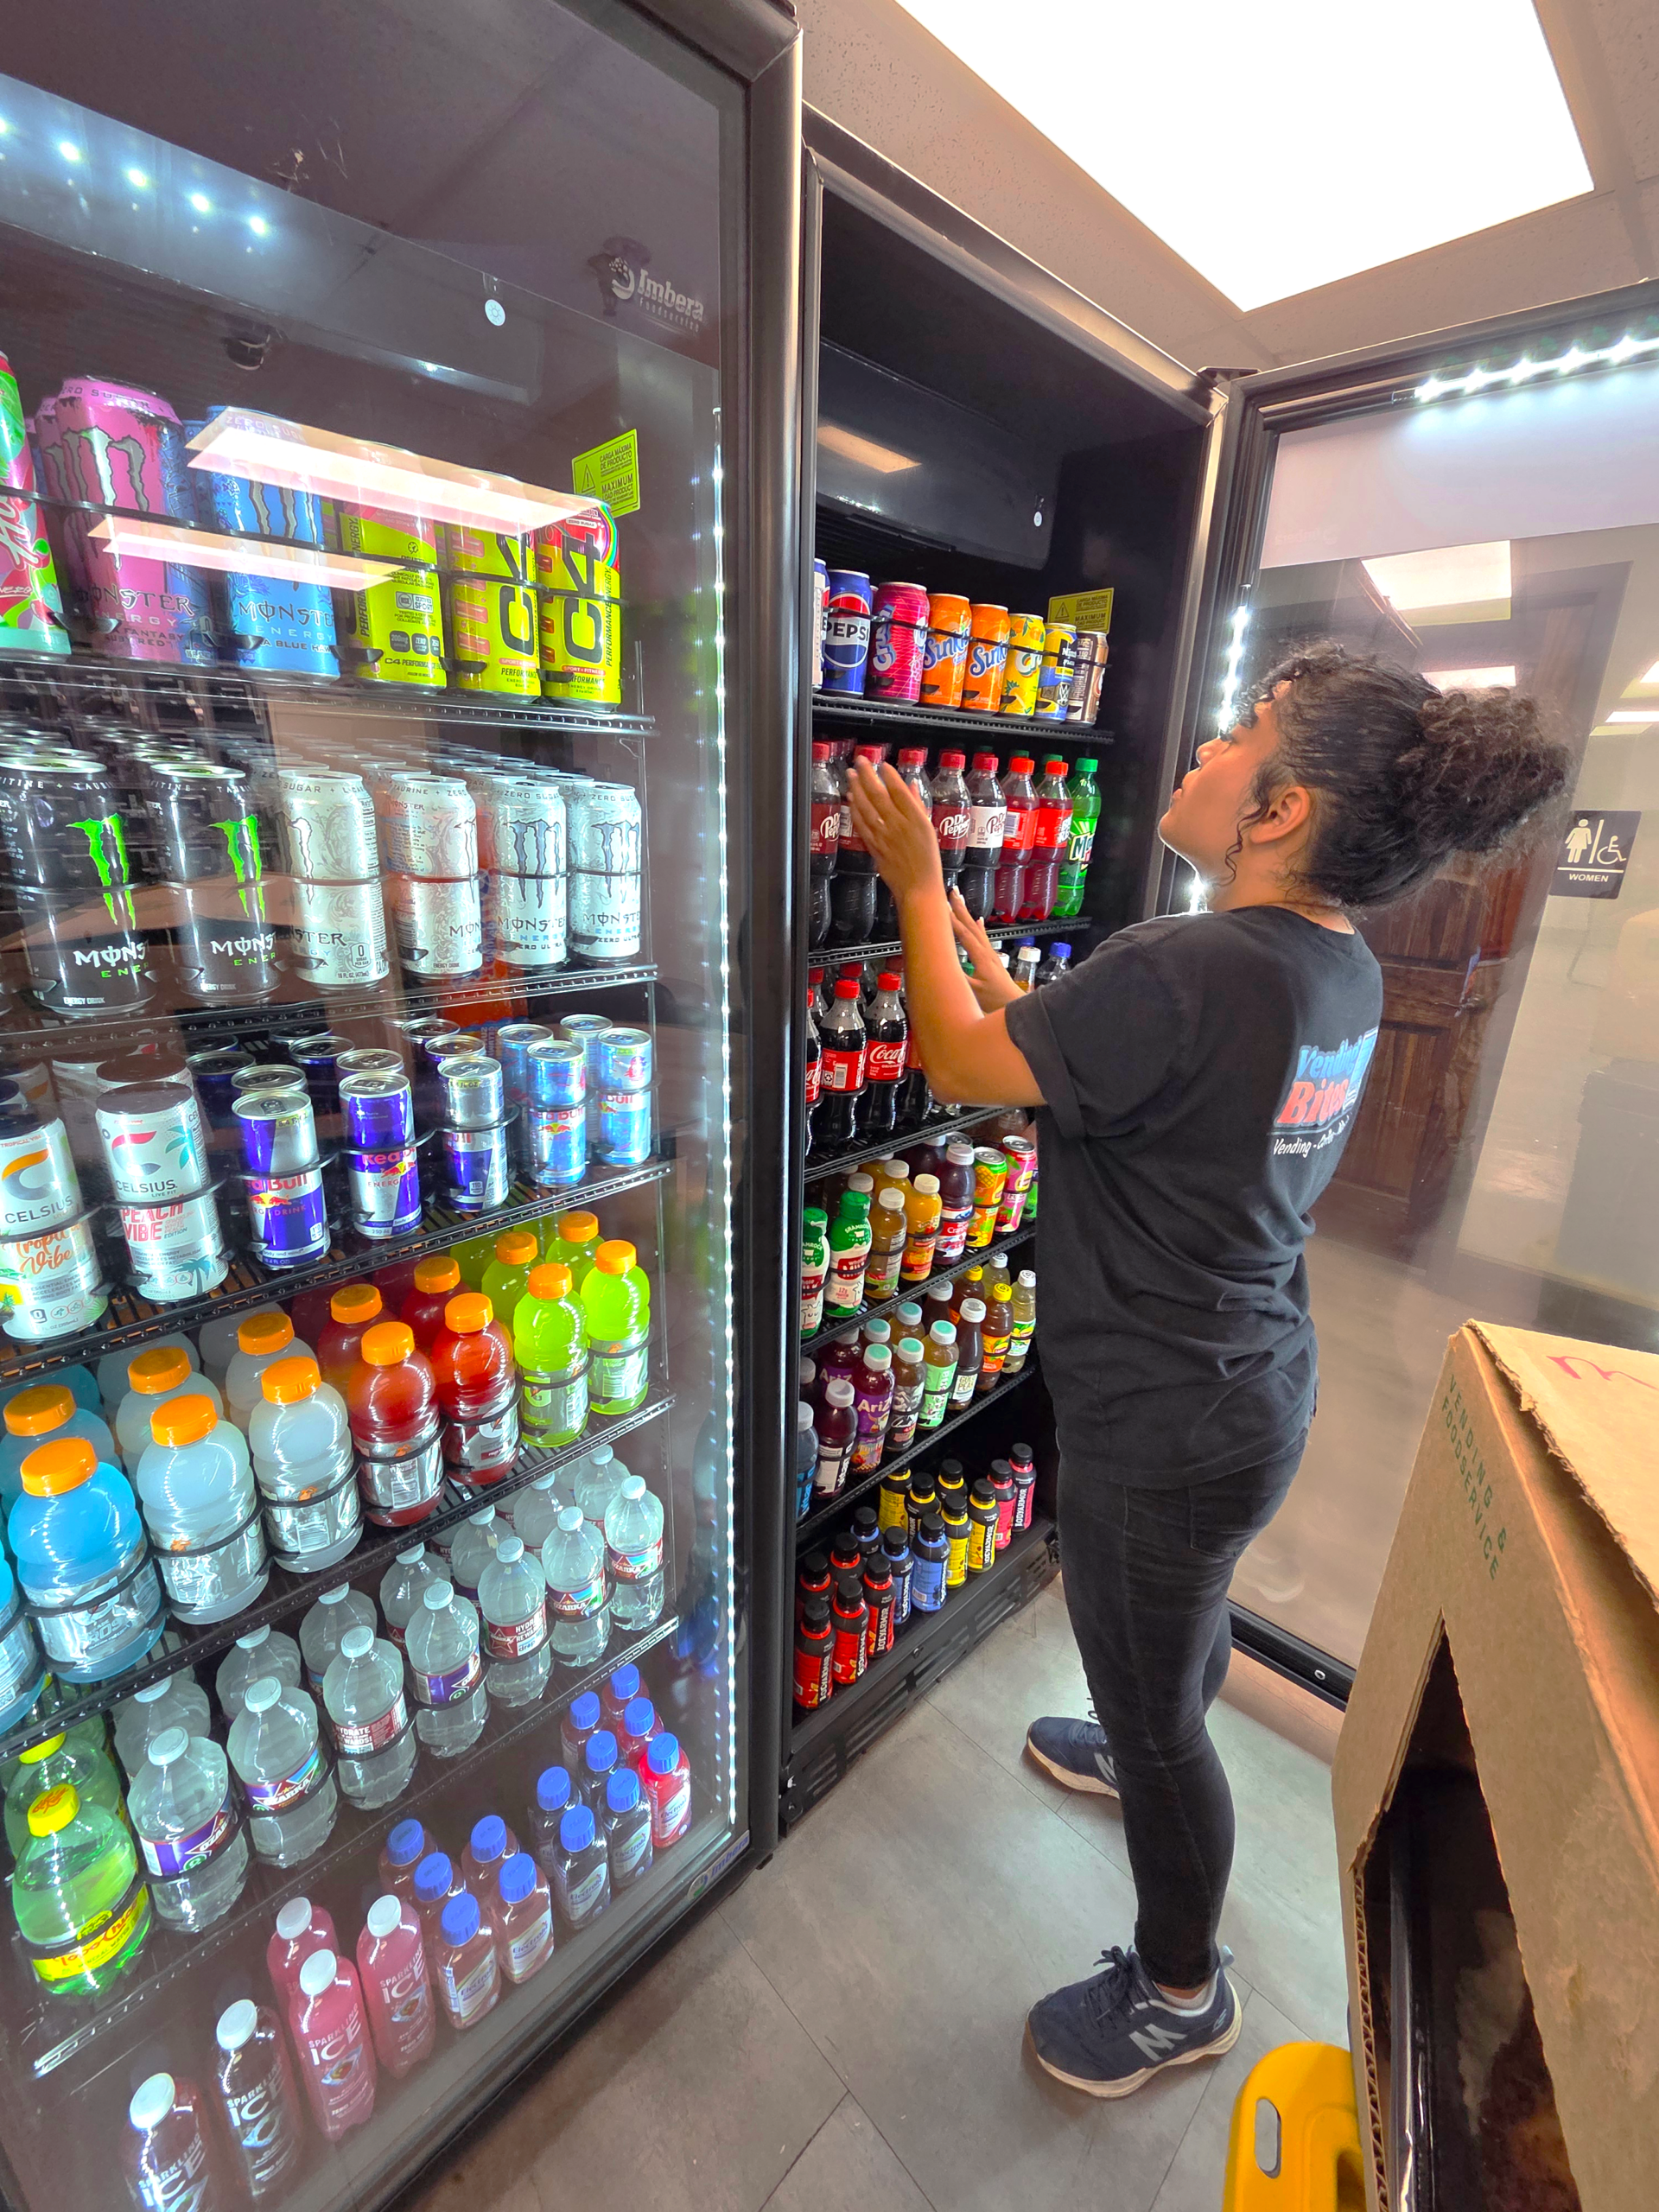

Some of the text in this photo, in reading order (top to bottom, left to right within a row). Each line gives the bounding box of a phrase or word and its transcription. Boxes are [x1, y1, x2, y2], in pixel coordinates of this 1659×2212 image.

[638, 269, 704, 321] Imbera
[607, 450, 632, 467] PRODUCTO
[601, 474, 633, 493] MAXIMUM
[415, 602, 433, 612] SPORT
[563, 533, 603, 664] C4
[1075, 613, 1106, 621] MAXIMUM
[124, 628, 184, 642] FANTASY
[256, 625, 333, 642] ENERGY
[825, 622, 868, 642] PEPSI
[138, 636, 164, 647] RED
[275, 640, 308, 650] BLUE
[393, 785, 429, 796] TAURINE
[504, 790, 531, 799] ZERO
[955, 814, 967, 826] Dr
[1569, 874, 1609, 882] WOMEN
[358, 944, 364, 957] 0
[1297, 1037, 1362, 1079] Vending
[1277, 1078, 1349, 1123] Bites
[1, 1138, 30, 1147] TROPICAL
[1274, 1137, 1312, 1158] Vending
[268, 1173, 308, 1192] Bull
[4, 1195, 73, 1224] CELSIUS
[274, 1205, 306, 1217] DRINK
[124, 1221, 162, 1242] VIBE
[164, 1227, 188, 1239] EDITION
[19, 1249, 73, 1275] Vibe
[31, 1280, 63, 1291] ESSENTIAL
[1450, 1374, 1493, 1509] VENDING
[518, 1640, 536, 1652] drop
[264, 1779, 311, 1806] OZARKA
[382, 1950, 425, 2004] ICE
[311, 2011, 362, 2066] ICE
[229, 2074, 286, 2127] ICE
